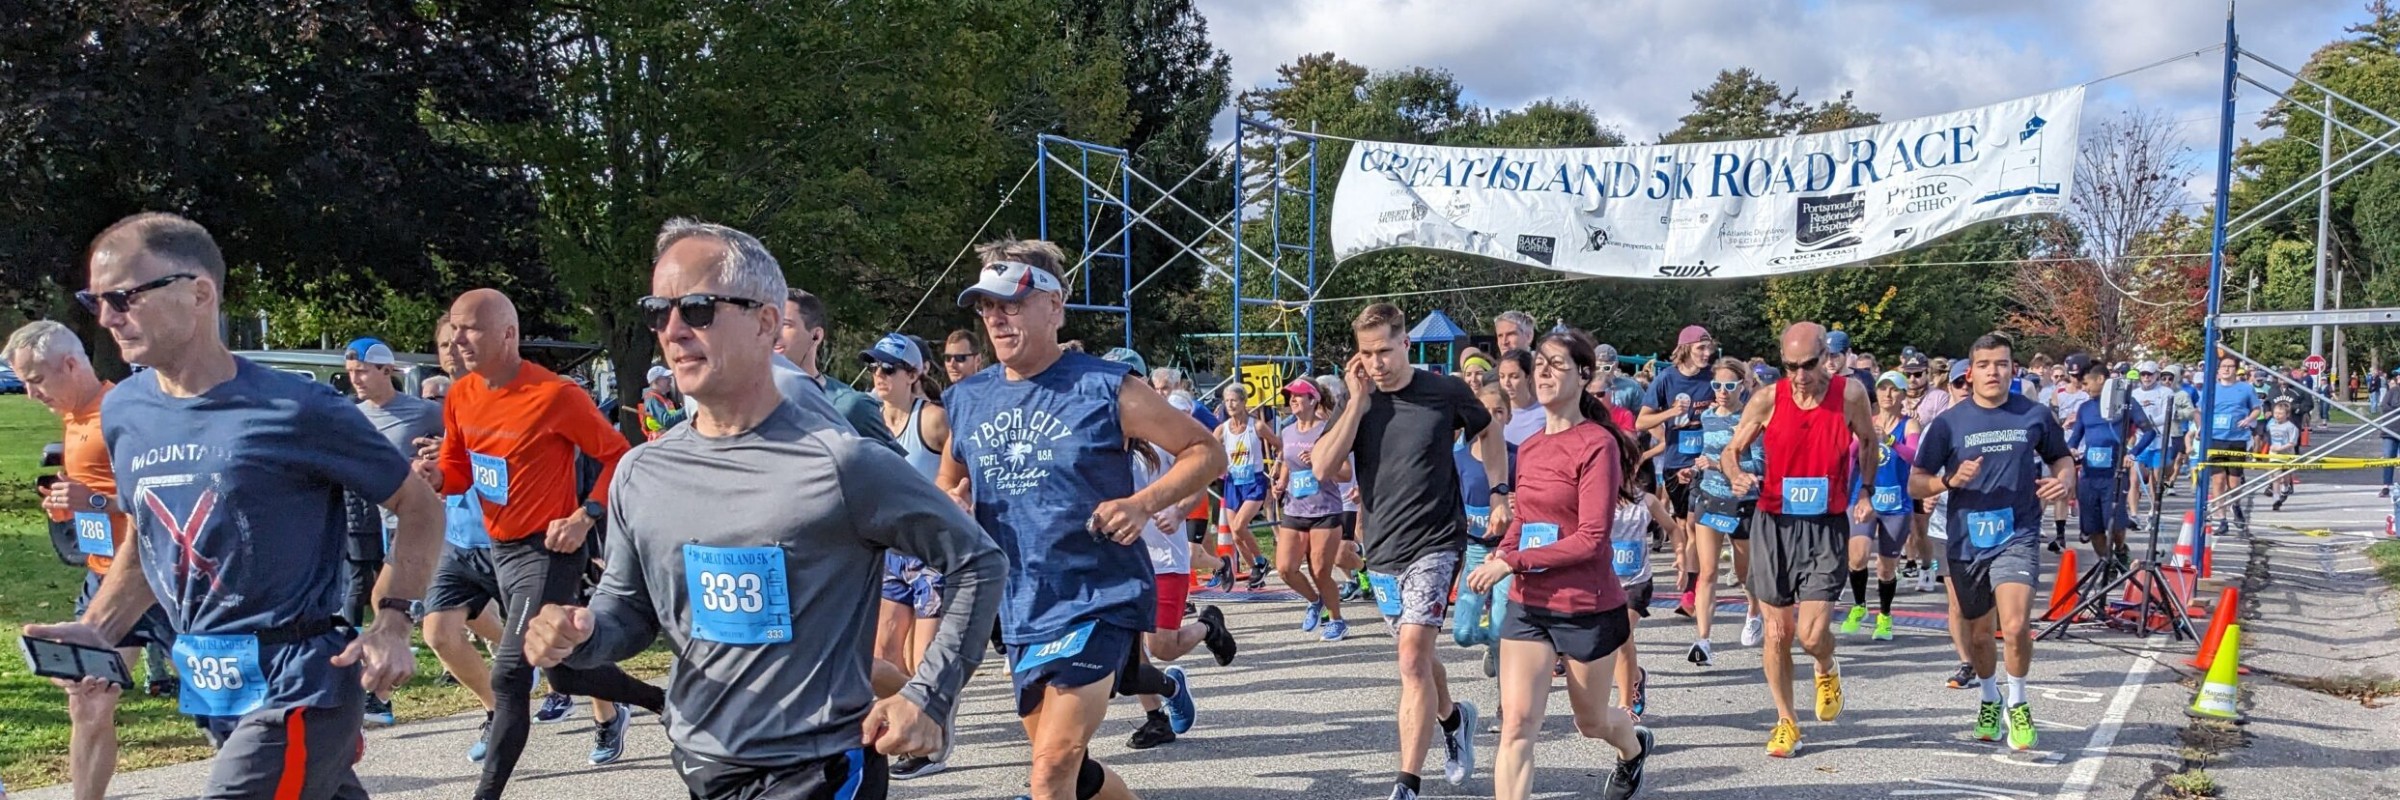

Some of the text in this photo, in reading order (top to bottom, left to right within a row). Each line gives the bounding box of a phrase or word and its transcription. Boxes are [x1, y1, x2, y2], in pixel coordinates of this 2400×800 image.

[1360, 124, 1980, 200] GREAT ISLAND 5K ROAD RACE
[1887, 181, 1948, 204] Prime
[1802, 200, 1860, 213] Portsmouth
[1810, 210, 1853, 224] Regional
[1726, 229, 1752, 237] Atlantic
[1809, 220, 1852, 234] Hospital
[1519, 235, 1548, 246] BAKER
[1518, 244, 1553, 254] PROPERTIES
[1790, 252, 1824, 260] ROCKY
[1828, 247, 1858, 257] COAST
[2304, 361, 2324, 370] STOP
[968, 407, 1073, 448] YBOR CITY
[990, 429, 1040, 448] ORIGINAL
[1964, 430, 2029, 448] MERRIMACK
[1037, 449, 1053, 461] USA
[1981, 444, 2013, 453] SOCCER
[979, 454, 1000, 467] YCFL
[2092, 452, 2107, 461] 127
[983, 466, 1051, 483] Florida
[1790, 487, 1819, 503] 207
[1876, 493, 1896, 504] 706
[80, 518, 105, 540] 286
[1976, 519, 2005, 537] 714
[701, 551, 721, 565] GREAT
[723, 552, 756, 566] ISLAND
[757, 552, 769, 566] 5K
[700, 570, 763, 613] 333
[767, 629, 785, 640] 333
[1035, 630, 1079, 657] 457
[187, 655, 243, 691] 335
